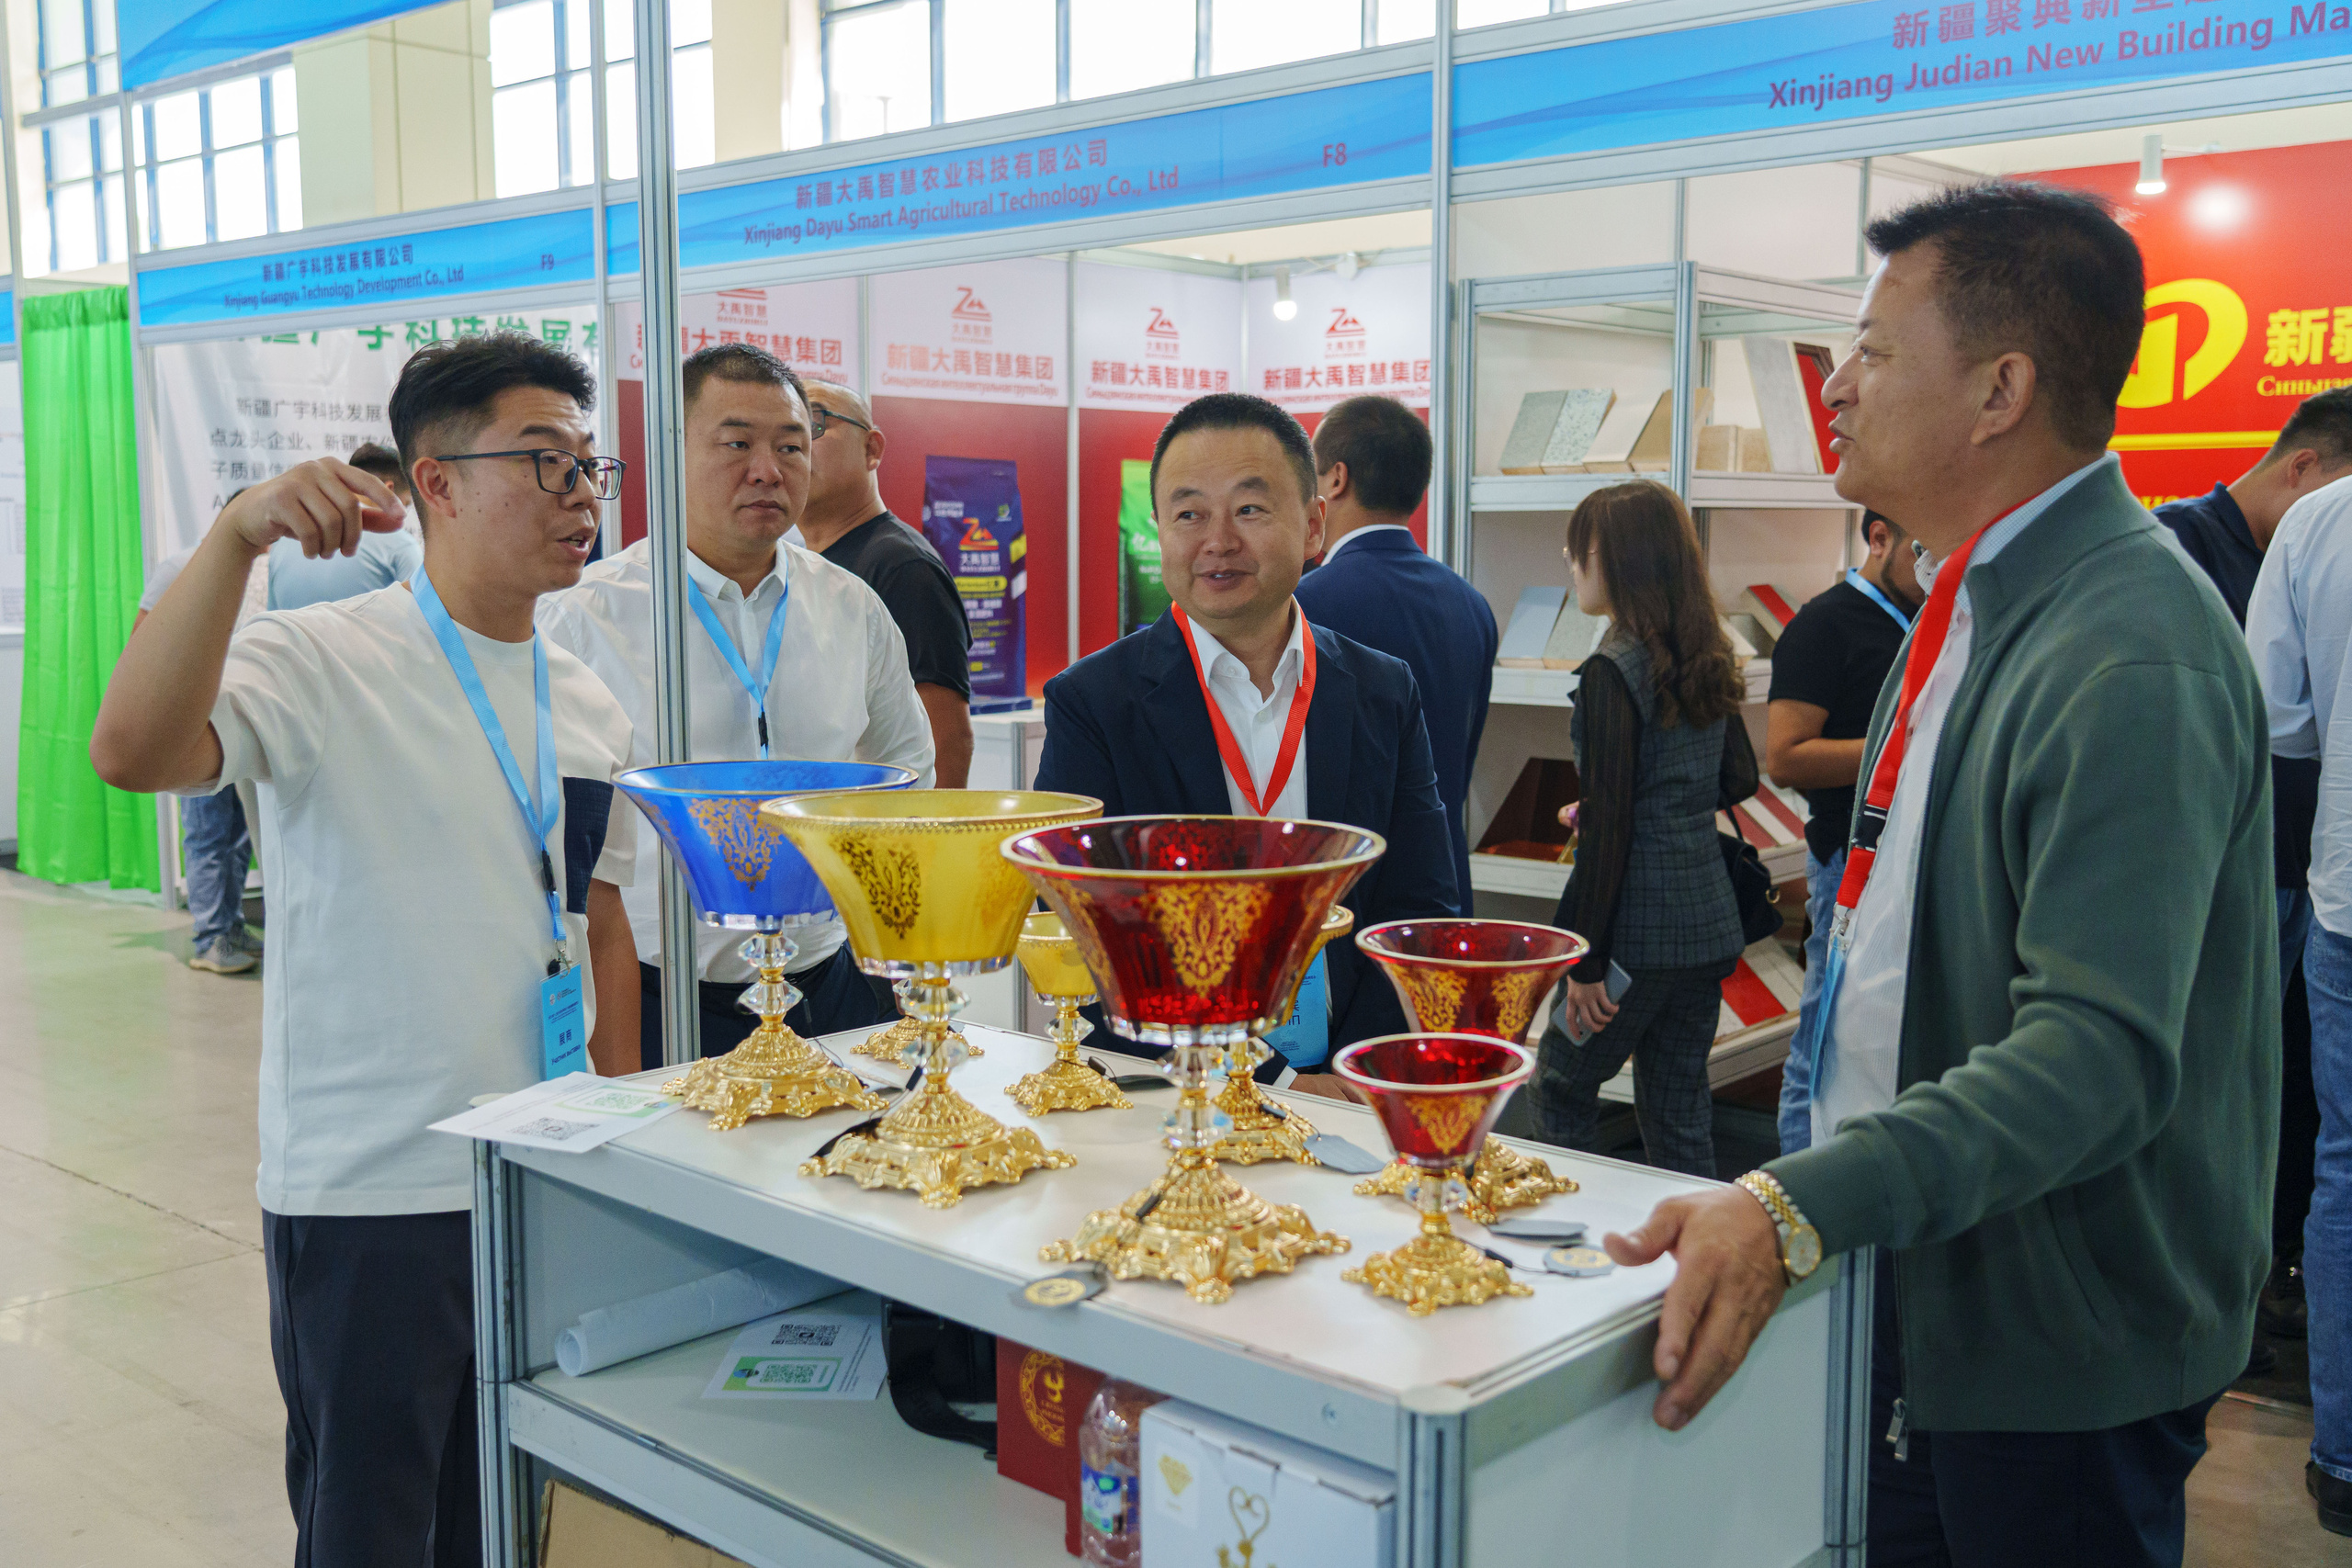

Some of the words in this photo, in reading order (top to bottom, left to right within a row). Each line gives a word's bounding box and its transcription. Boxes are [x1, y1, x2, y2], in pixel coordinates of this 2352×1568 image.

[1769, 73, 1894, 111] Xinjiang
[1904, 53, 2013, 90] Judian
[2026, 42, 2105, 73] New
[2118, 16, 2274, 61] Building
[796, 139, 1107, 210] 新疆大禹智慧农业科技有限公司
[1323, 142, 1348, 168] F8
[744, 222, 801, 247] Xinjiang
[807, 218, 843, 240] Dayu
[848, 210, 893, 231] Smart
[898, 193, 994, 229] Agricultural
[999, 183, 1102, 212] Technology
[1107, 175, 1142, 197] Co.,
[1148, 165, 1179, 192] Ltd
[541, 253, 555, 271] F9
[224, 294, 259, 311] Xinjiang
[261, 289, 300, 308] Guangyu
[301, 282, 355, 300] Technology
[357, 271, 423, 294] Development
[425, 268, 445, 286] Co.,
[447, 265, 464, 283] Ltd
[887, 343, 1054, 381] 新疆大禹智慧集团
[1091, 361, 1229, 391] 新疆大禹智慧集团
